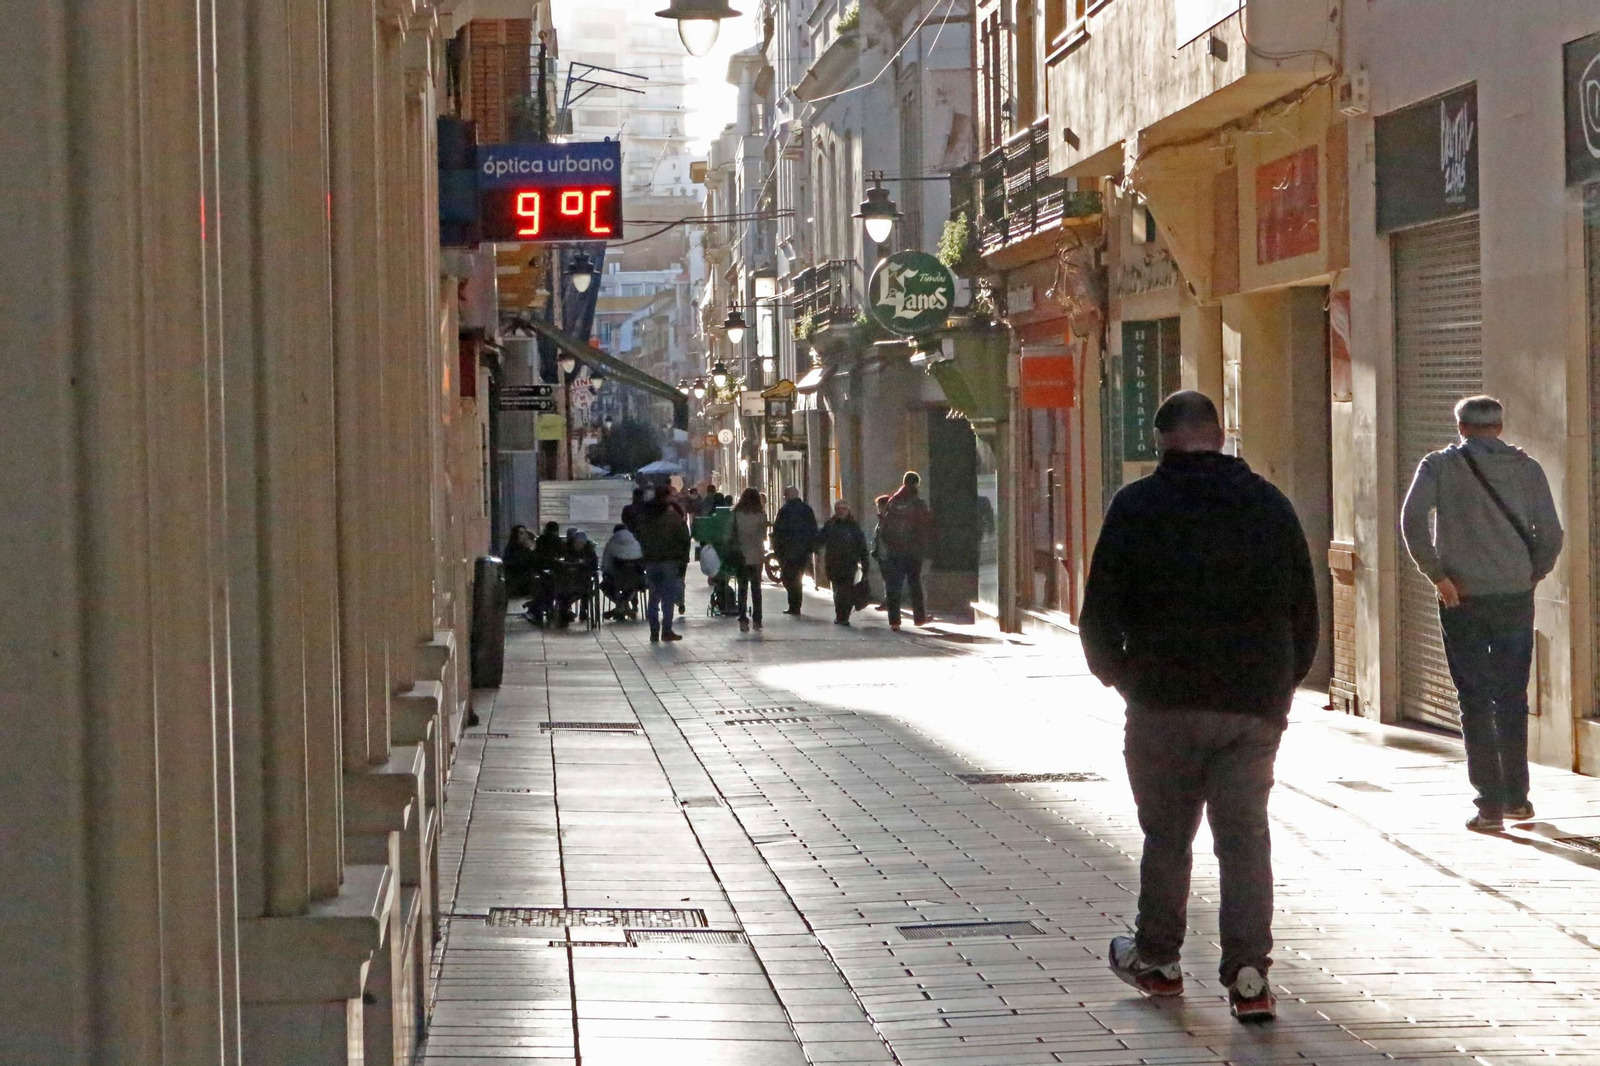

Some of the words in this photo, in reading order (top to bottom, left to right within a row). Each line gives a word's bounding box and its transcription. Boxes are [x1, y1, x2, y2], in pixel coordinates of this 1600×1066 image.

[483, 157, 544, 178] óptica
[547, 155, 615, 173] urbano
[1135, 329, 1146, 452] Herbolario
